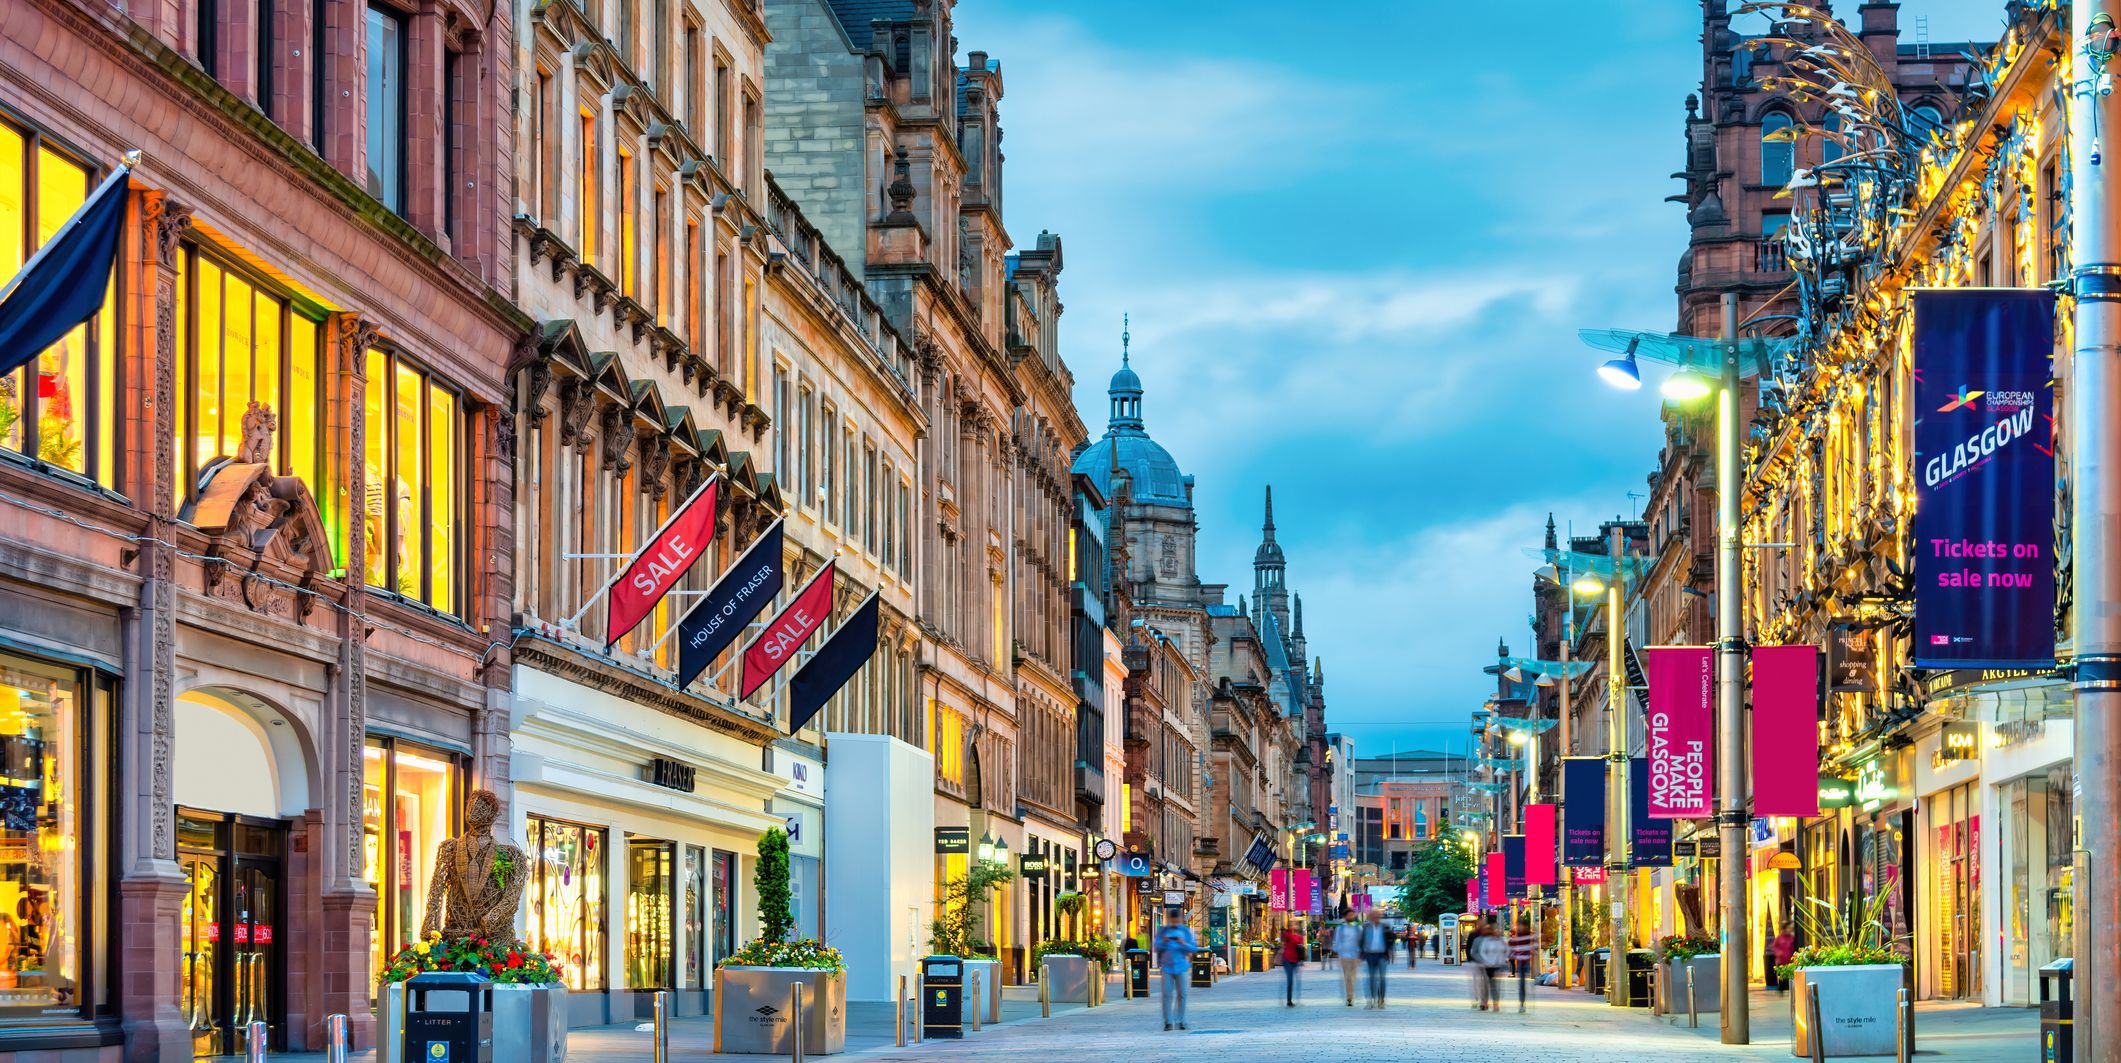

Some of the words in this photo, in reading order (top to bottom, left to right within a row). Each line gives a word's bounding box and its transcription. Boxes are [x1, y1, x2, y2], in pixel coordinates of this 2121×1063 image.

[1986, 391, 2034, 400] EUROPEAN
[1926, 405, 2034, 487] GLASGOW
[633, 534, 694, 596] SALE
[1930, 538, 2007, 558] Tickets
[2013, 543, 2039, 558] on
[1938, 567, 1982, 588] sale
[1988, 573, 2033, 588] now
[690, 613, 725, 649] HOUSE
[723, 598, 739, 616] OF
[736, 564, 774, 602] FRASER
[763, 608, 815, 660] SALE
[1840, 660, 1867, 669] shopping
[1843, 676, 1863, 686] dining
[1948, 733, 1973, 748] KM
[793, 761, 807, 783] KIKO
[1652, 712, 1669, 809] GLASGOW
[1687, 740, 1703, 809] PEOPLE
[1670, 755, 1686, 809] MAKE
